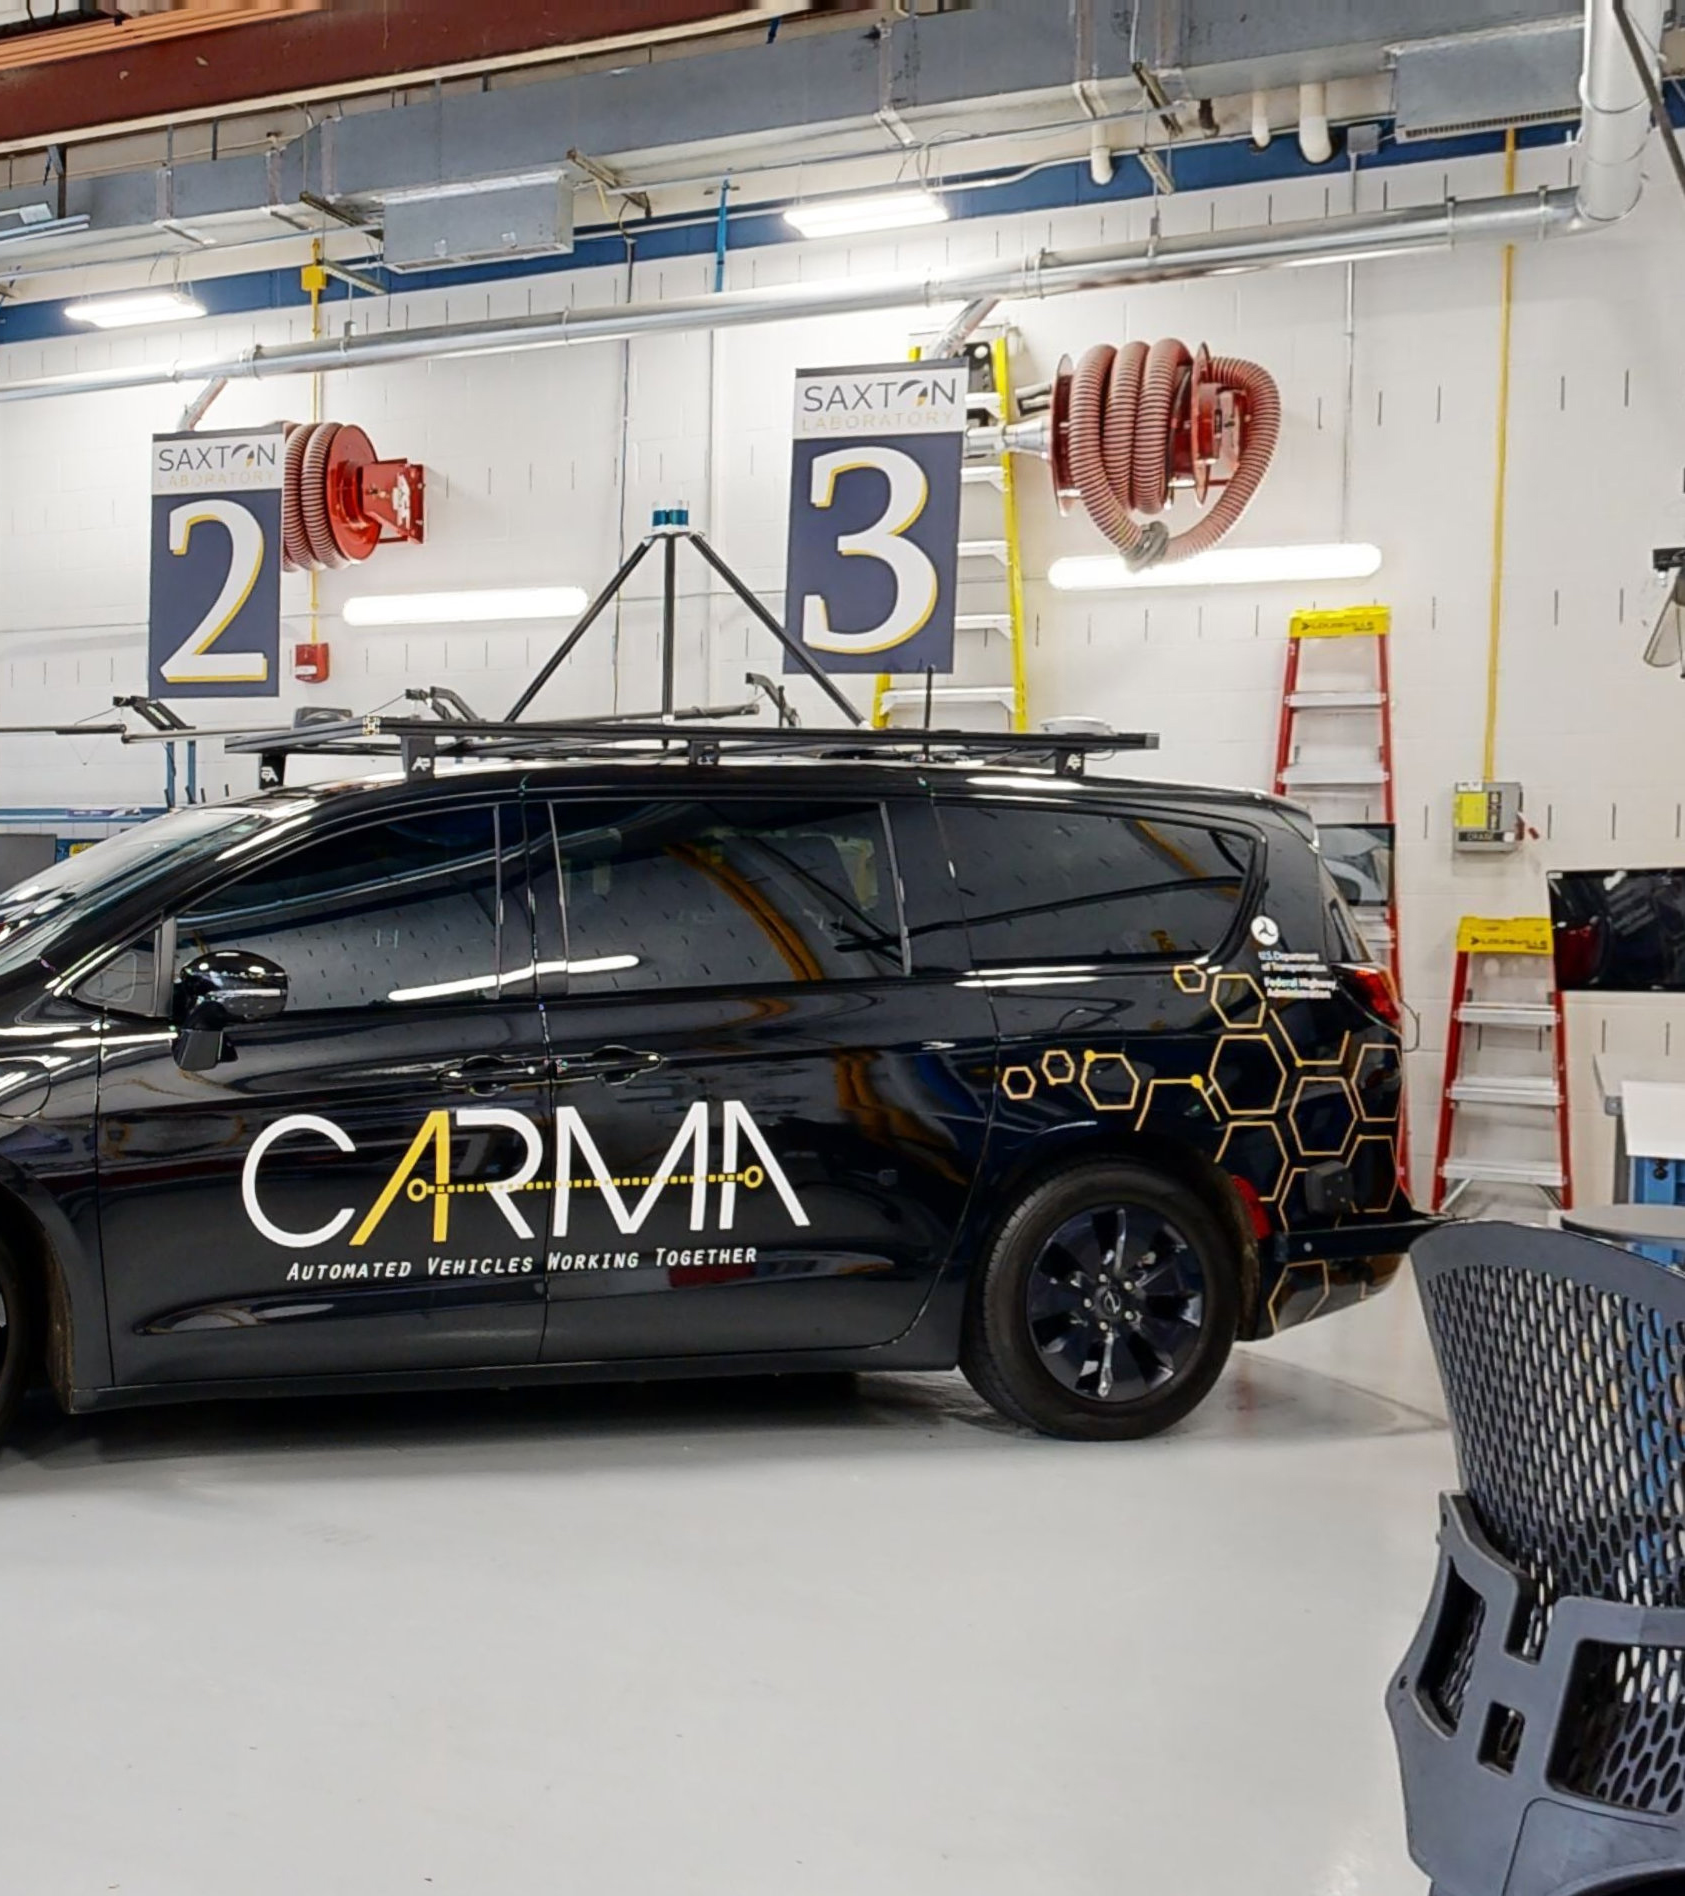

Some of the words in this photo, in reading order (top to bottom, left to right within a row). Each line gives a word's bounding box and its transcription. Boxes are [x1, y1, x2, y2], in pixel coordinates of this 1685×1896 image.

[803, 378, 956, 412] SAXTON
[802, 411, 955, 432] LABORATORY
[158, 443, 275, 472] SAXTON
[802, 446, 938, 655] 3
[160, 499, 268, 683] 2
[242, 1100, 810, 1248] CARMA
[287, 1261, 412, 1281] AUTOMATED
[427, 1256, 534, 1276] VEHICLES
[547, 1251, 639, 1271] WORKING
[655, 1247, 757, 1267] TOGETHER
